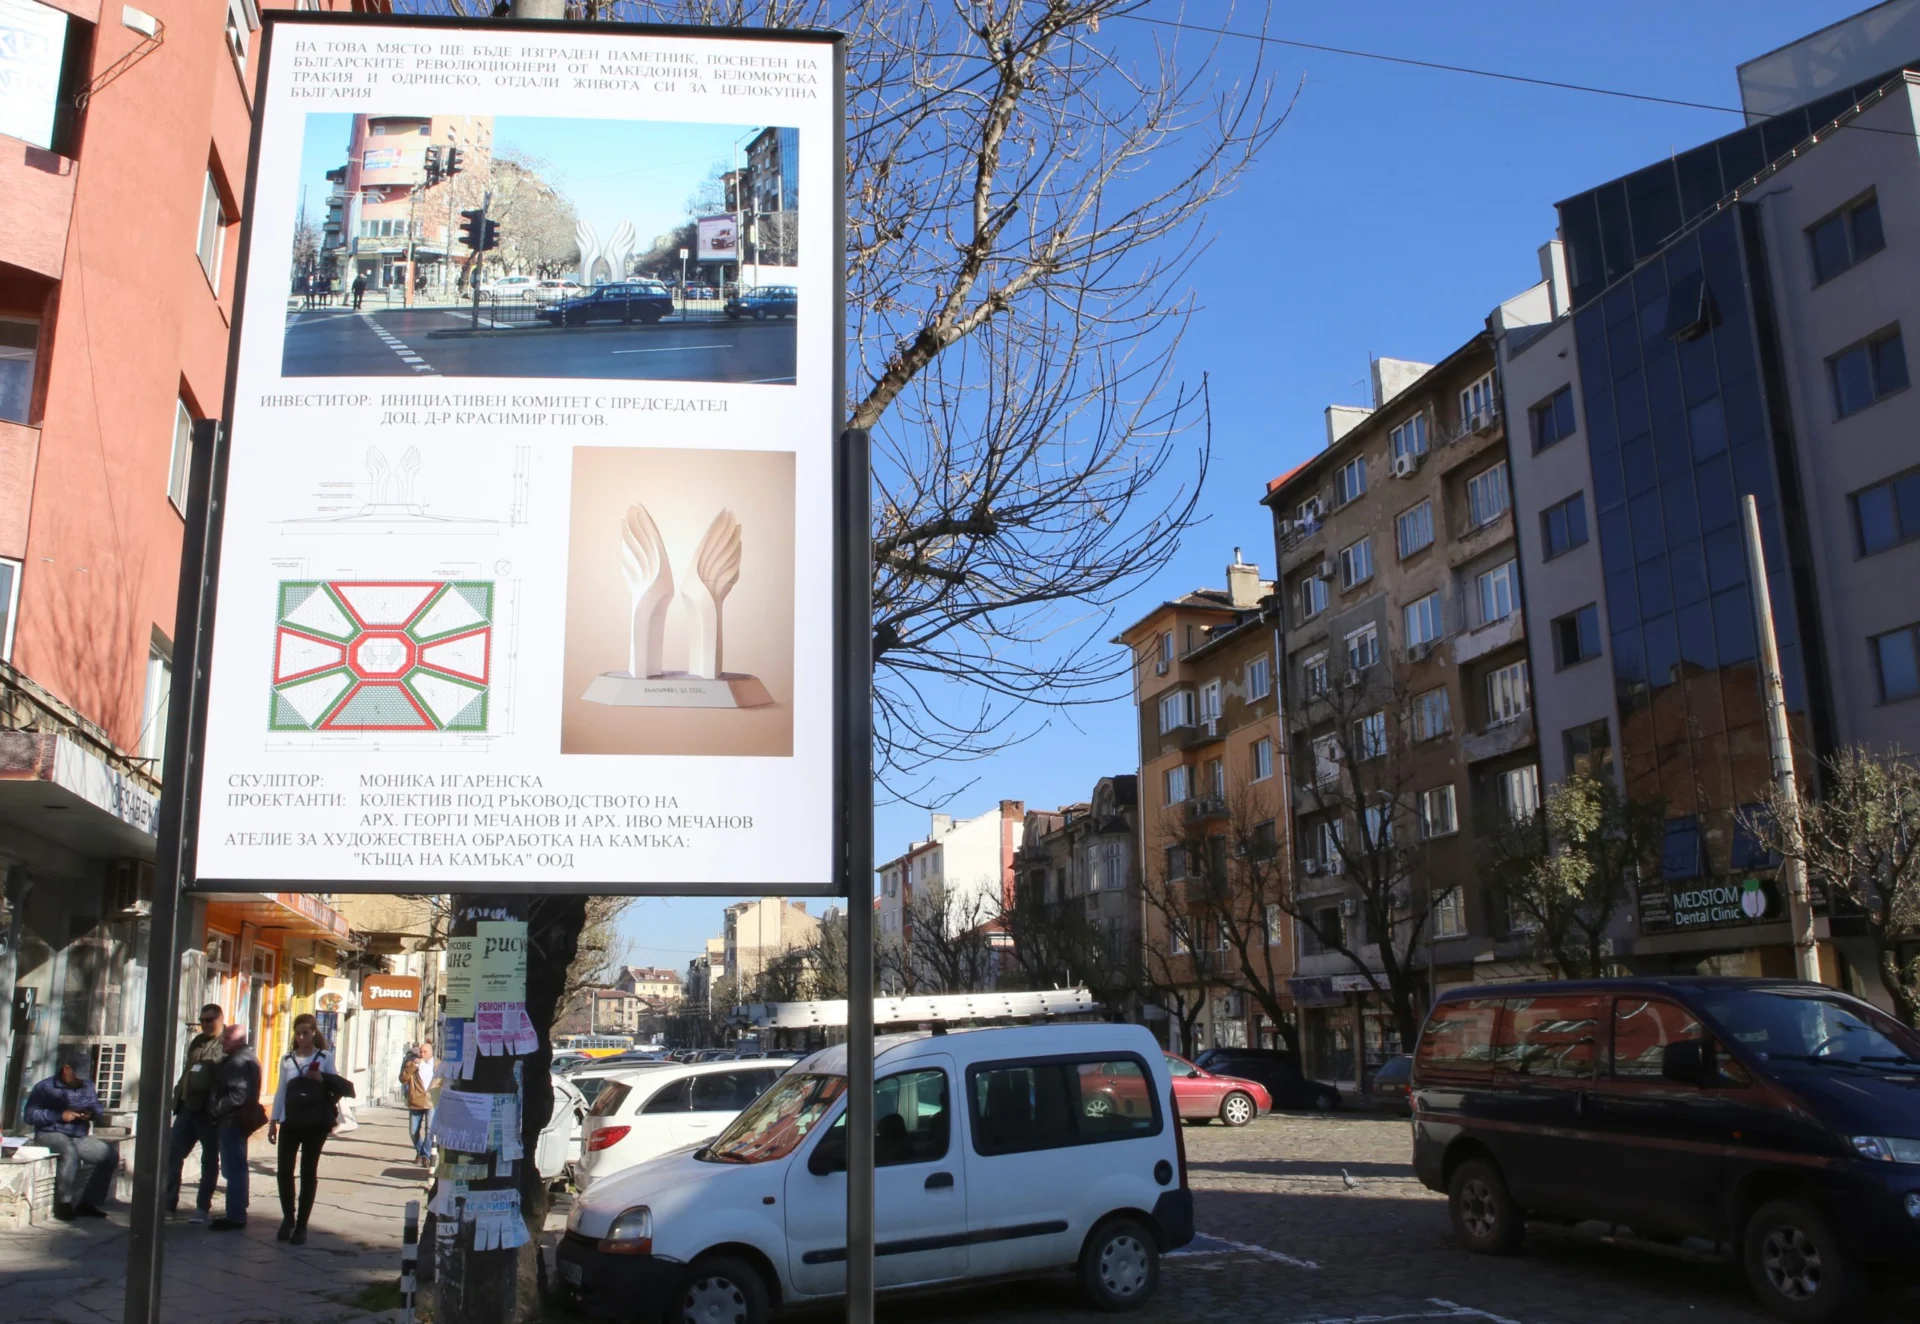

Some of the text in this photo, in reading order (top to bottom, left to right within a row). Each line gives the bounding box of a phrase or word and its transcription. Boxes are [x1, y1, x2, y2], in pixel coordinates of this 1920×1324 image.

[295, 41, 818, 70] НА ТОВА МЯСТО ЩЕ БЪДЕ ИЗГРАДЕН ПАМЕТНИК, ПОСВЕТЕН НА
[293, 56, 817, 84] БЪЛГАРСКИТЕ РЕВОЛЮЦИОНЕРИ ОТ МАКЕДОНИЯ, БЕЛОМОРСКА
[290, 87, 371, 98] БЪЛГАРИЯ
[292, 72, 818, 99] ТРАКИЯ И ОДРИНСКО, ОТДАЛИ ЖИВОТА СИ ЗА ЦЕЛОКУПНА
[260, 394, 728, 413] ИНВЕСТИТОР: ИНИЦИАТИВЕН КОМИТЕТ С ПРЕДСЕДАТЕЛ
[381, 411, 420, 426] ДОЦ.
[424, 412, 451, 425] Д-Р
[455, 412, 546, 425] КРАСИМИР
[228, 773, 543, 789] СКУЛПТОР: МОНИКА ИГАРЕНСКА
[227, 793, 679, 809] ПРОЕКТАНТИ: КОЛЕКТИВ ПОД РЪКОВОДСТВОТО НА
[360, 813, 754, 829] АРХ. ГЕОРГИ МЕЧАНОВ И АРХ. ИВО МЕЧАНОВ
[224, 832, 691, 848] АТЕЛИЕ ЗА ХУДОЖЕСТВЕНА ОБРАБОТКА НА КАМЪКА:
[354, 852, 575, 868] "КЪЩА НА КАМЪКА" ООД
[1673, 886, 1738, 909] MEDSTOM
[1675, 910, 1709, 925] Dental
[1711, 906, 1740, 921] Clinic
[478, 1002, 507, 1011] РЕМОНТ
